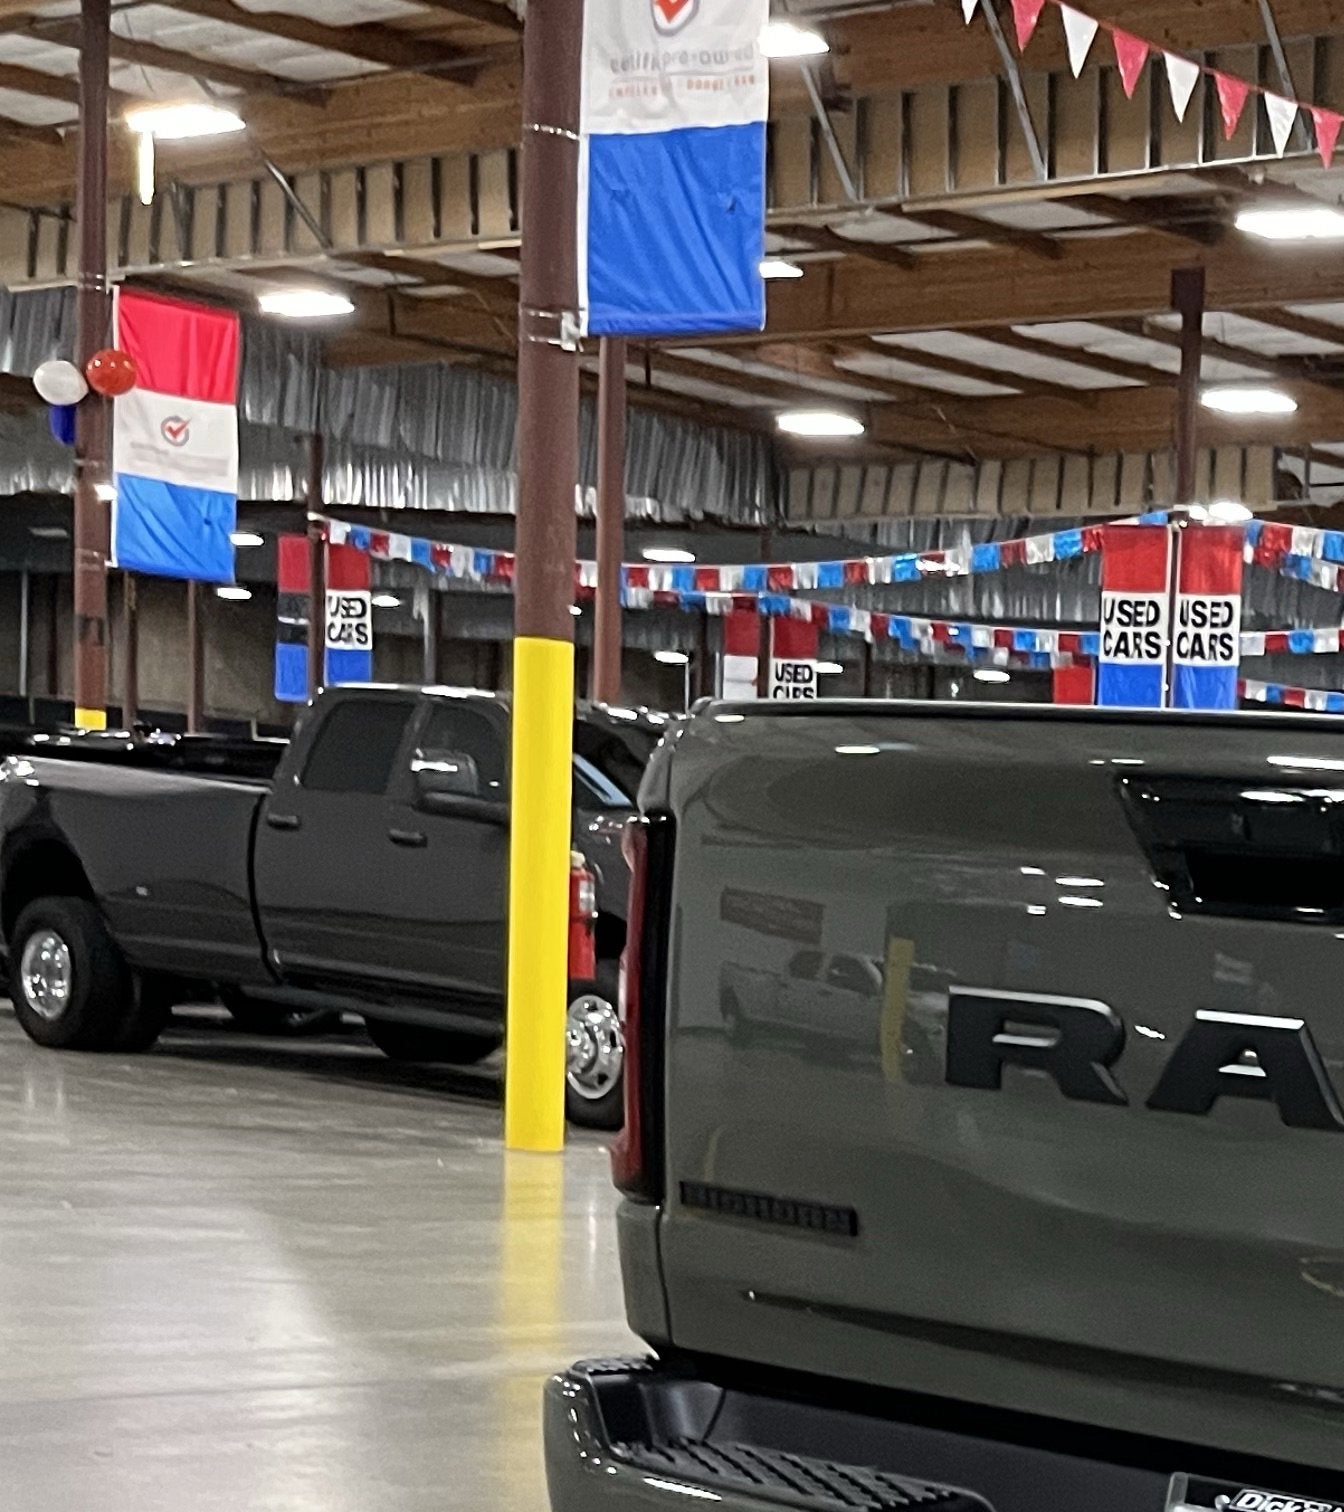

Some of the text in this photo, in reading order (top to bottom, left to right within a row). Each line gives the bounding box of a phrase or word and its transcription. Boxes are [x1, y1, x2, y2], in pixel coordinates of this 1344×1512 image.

[1103, 598, 1160, 628] USED
[1179, 600, 1233, 628] USED
[1103, 630, 1161, 659] CARS
[1176, 631, 1233, 661] CARS
[775, 662, 813, 683] USED
